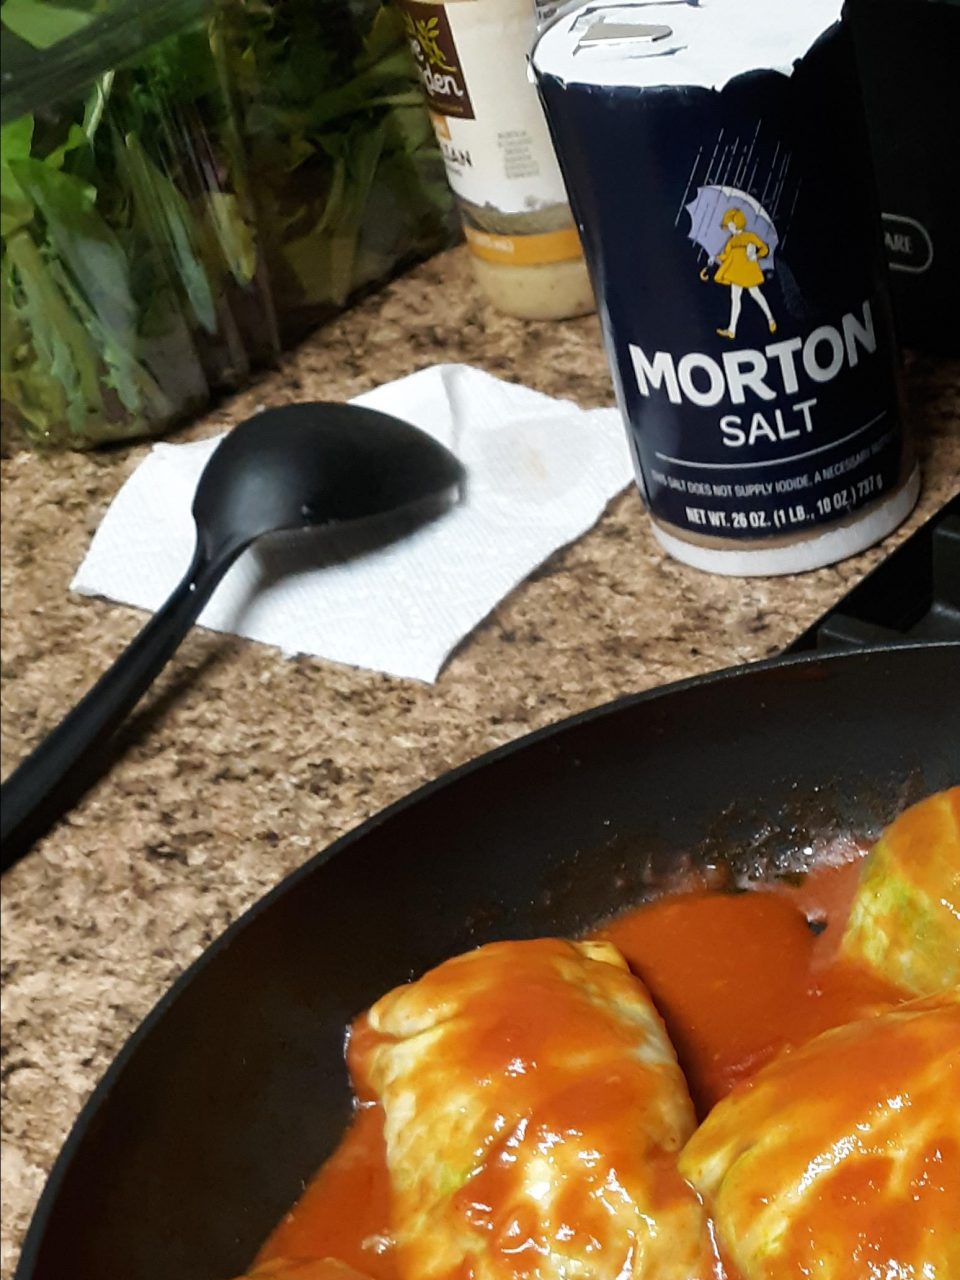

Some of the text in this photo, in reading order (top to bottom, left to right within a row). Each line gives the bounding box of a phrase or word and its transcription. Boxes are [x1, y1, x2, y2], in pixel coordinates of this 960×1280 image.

[628, 299, 877, 408] MORTON
[719, 398, 817, 447] SALT
[685, 505, 706, 525] NET
[707, 510, 731, 527] WT.
[731, 512, 747, 528] 26
[749, 511, 771, 527] OZ.
[773, 509, 786, 528] (1
[816, 496, 831, 516] 10
[857, 475, 874, 498] 737
[687, 481, 712, 496] DOES
[712, 484, 732, 497] NOT
[734, 482, 773, 497] SUPPLY
[814, 470, 822, 484] A
